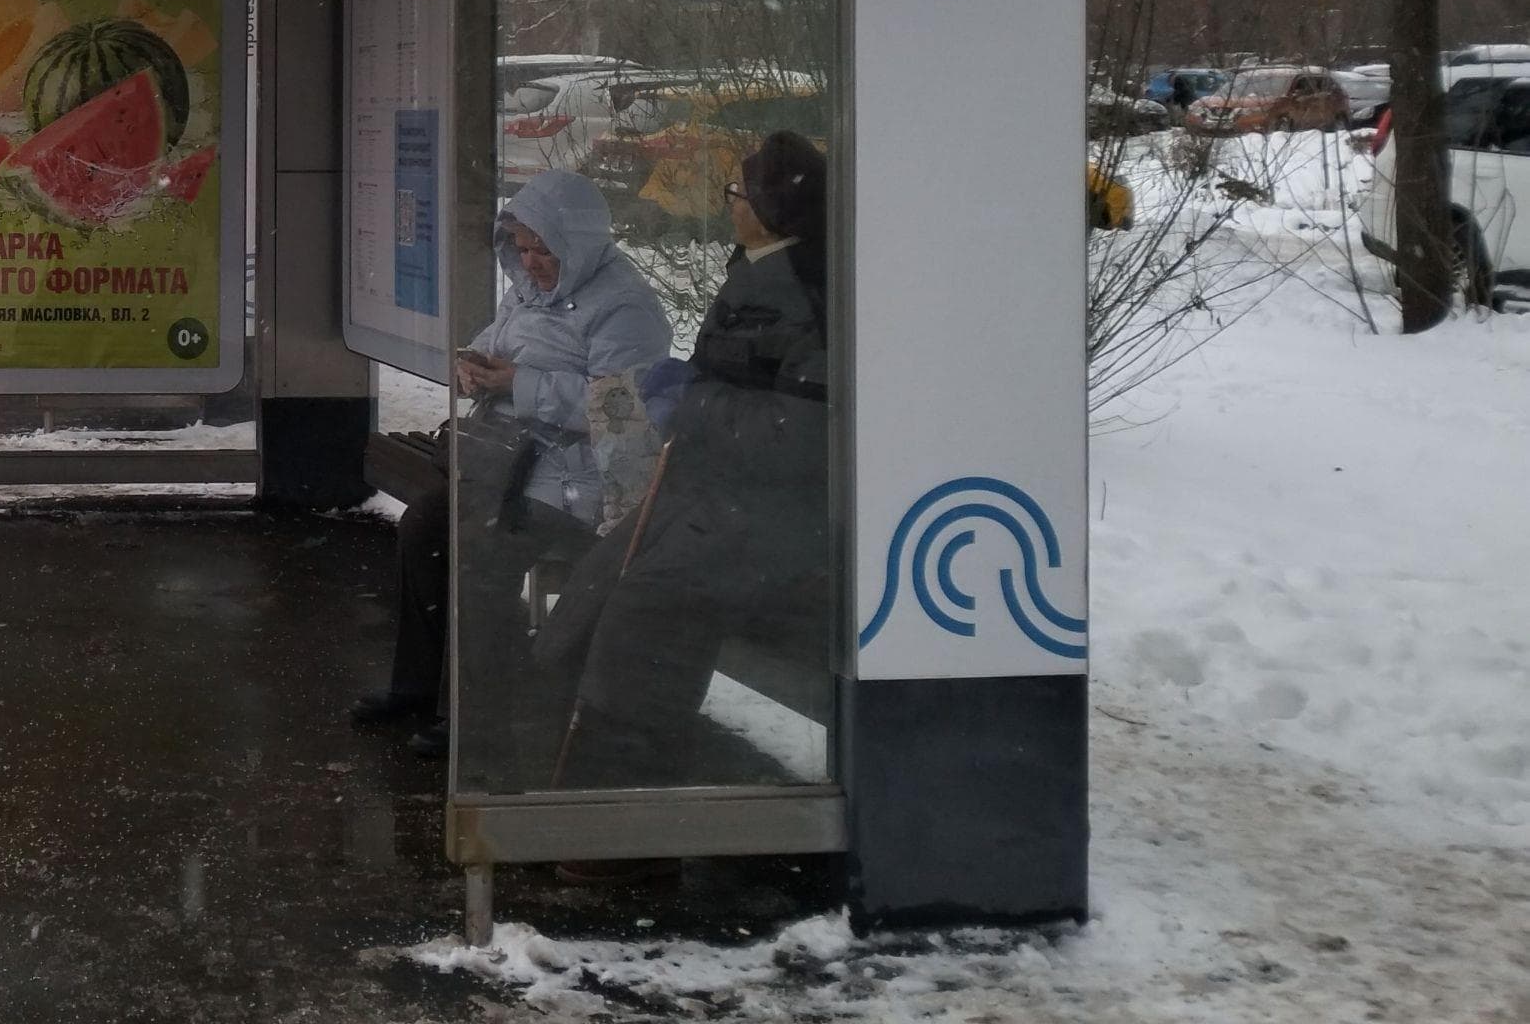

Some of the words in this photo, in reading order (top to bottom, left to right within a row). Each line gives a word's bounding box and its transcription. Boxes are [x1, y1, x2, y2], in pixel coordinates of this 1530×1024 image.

[45, 266, 189, 294] ФОРМАТА
[21, 307, 106, 323] МАСЛОВКА,
[111, 307, 136, 322] ВЛ.
[141, 307, 150, 322] 2
[177, 329, 202, 347] 0+
